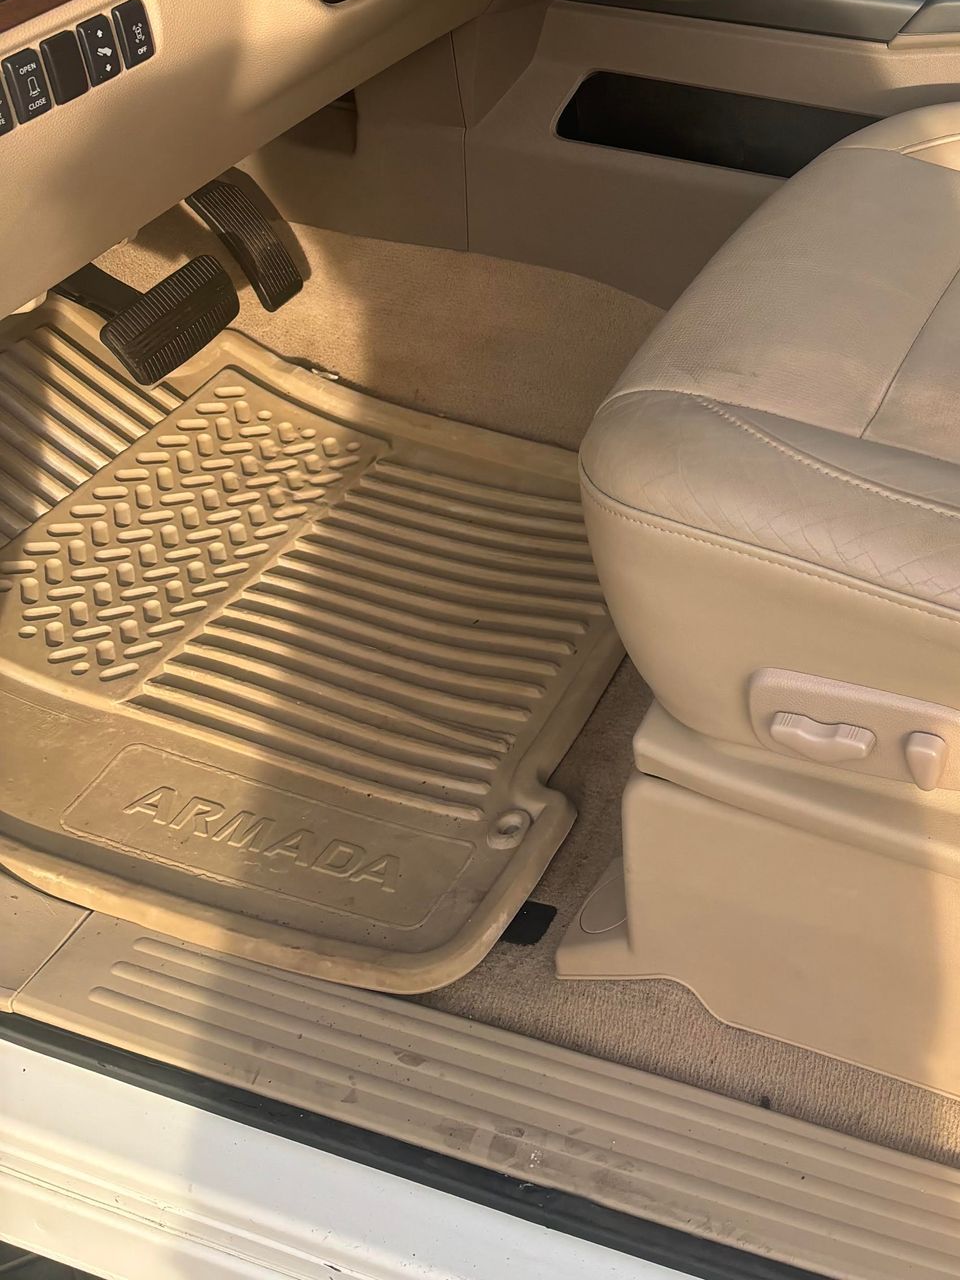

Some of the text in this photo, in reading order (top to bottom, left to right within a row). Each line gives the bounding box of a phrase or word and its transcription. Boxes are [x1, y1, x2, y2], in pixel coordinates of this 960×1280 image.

[137, 45, 148, 55] OFF
[19, 62, 37, 75] OPEN
[28, 97, 47, 111] CLOSE
[122, 785, 400, 893] ARMADA
